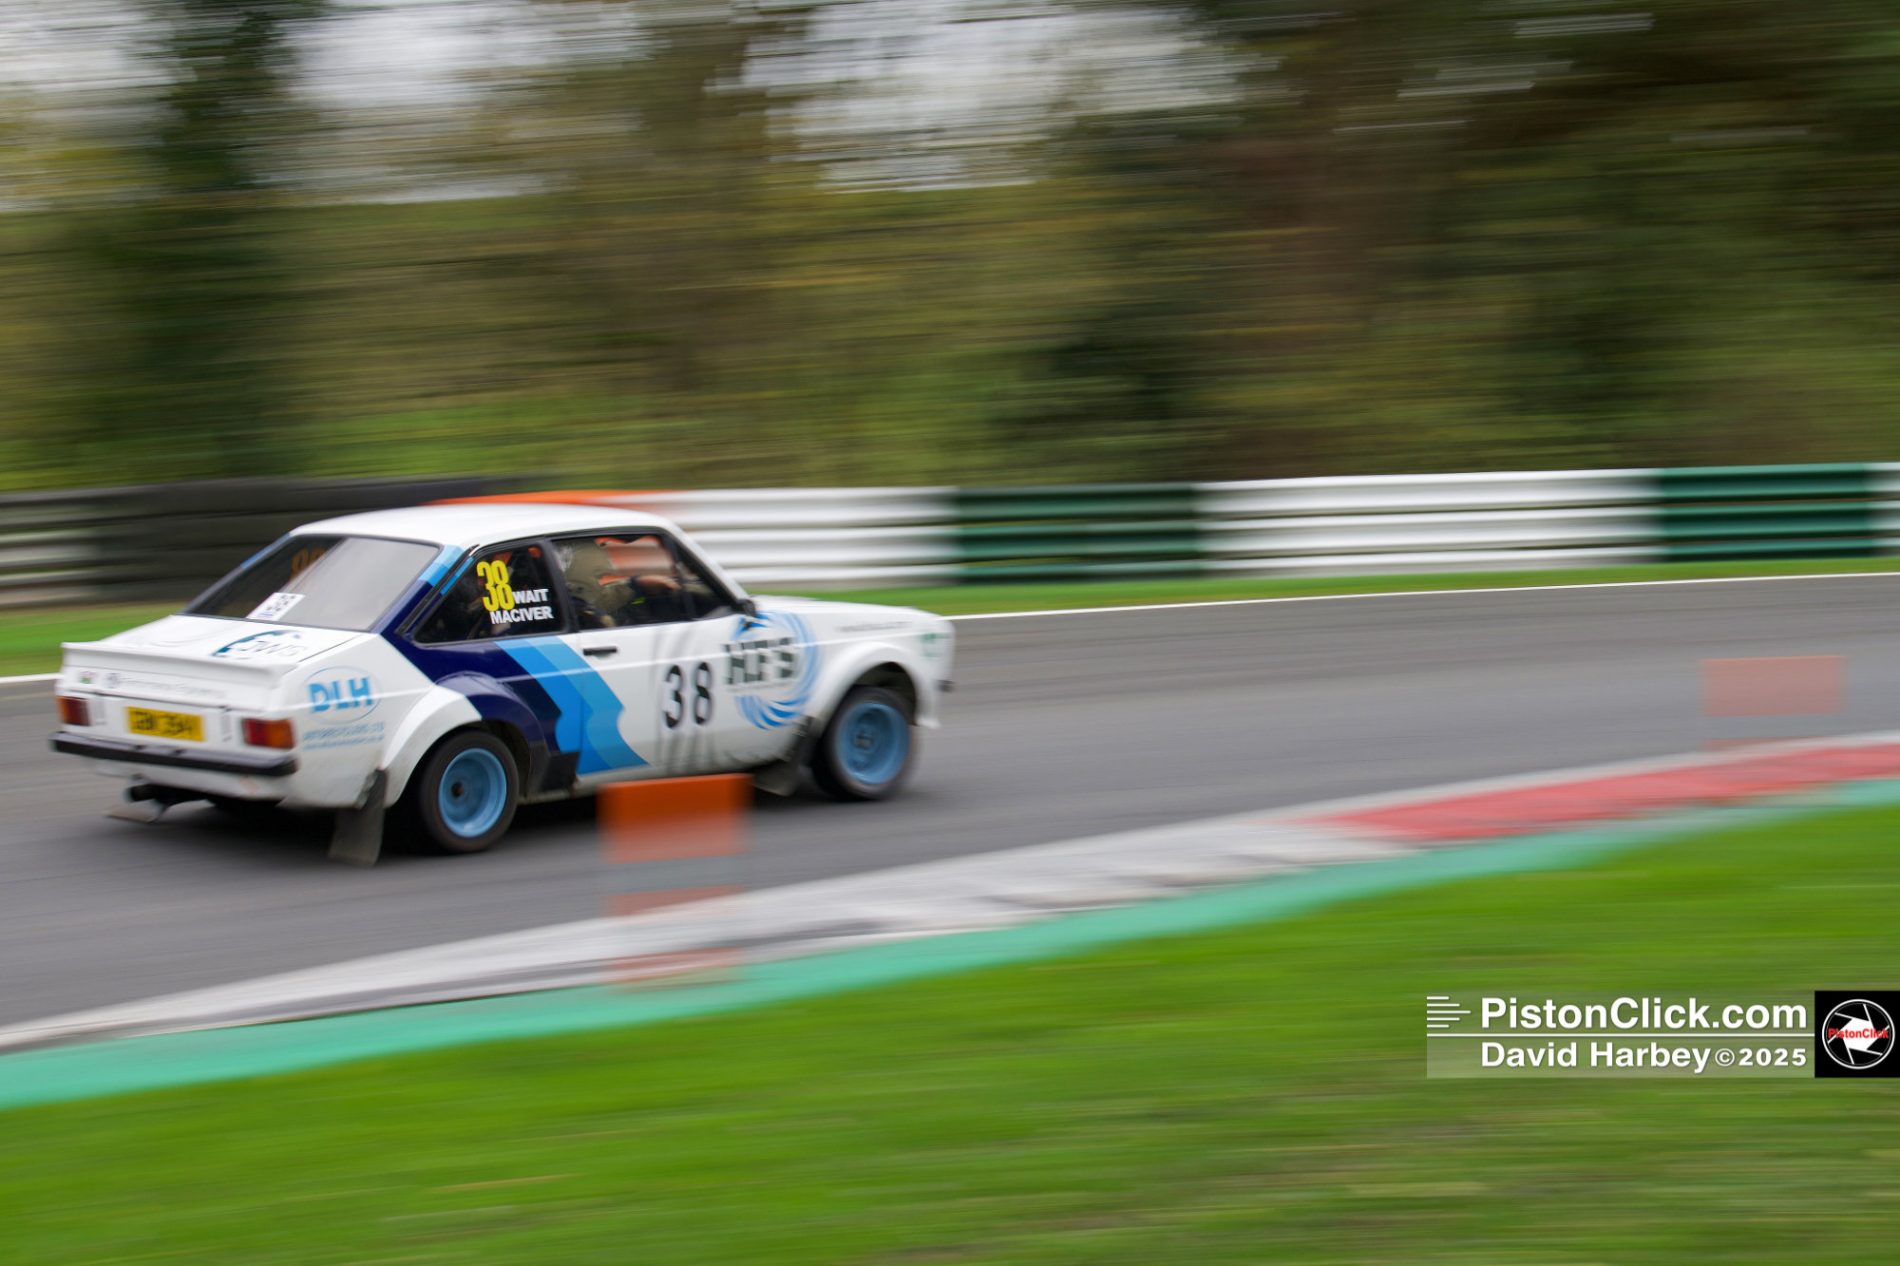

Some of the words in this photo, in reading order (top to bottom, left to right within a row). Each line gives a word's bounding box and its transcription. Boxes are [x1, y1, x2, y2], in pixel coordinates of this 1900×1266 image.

[476, 559, 516, 612] 38
[512, 588, 550, 605] WAIT
[490, 605, 555, 625] MACIVER
[308, 677, 373, 712] DLH
[662, 663, 712, 728] 38
